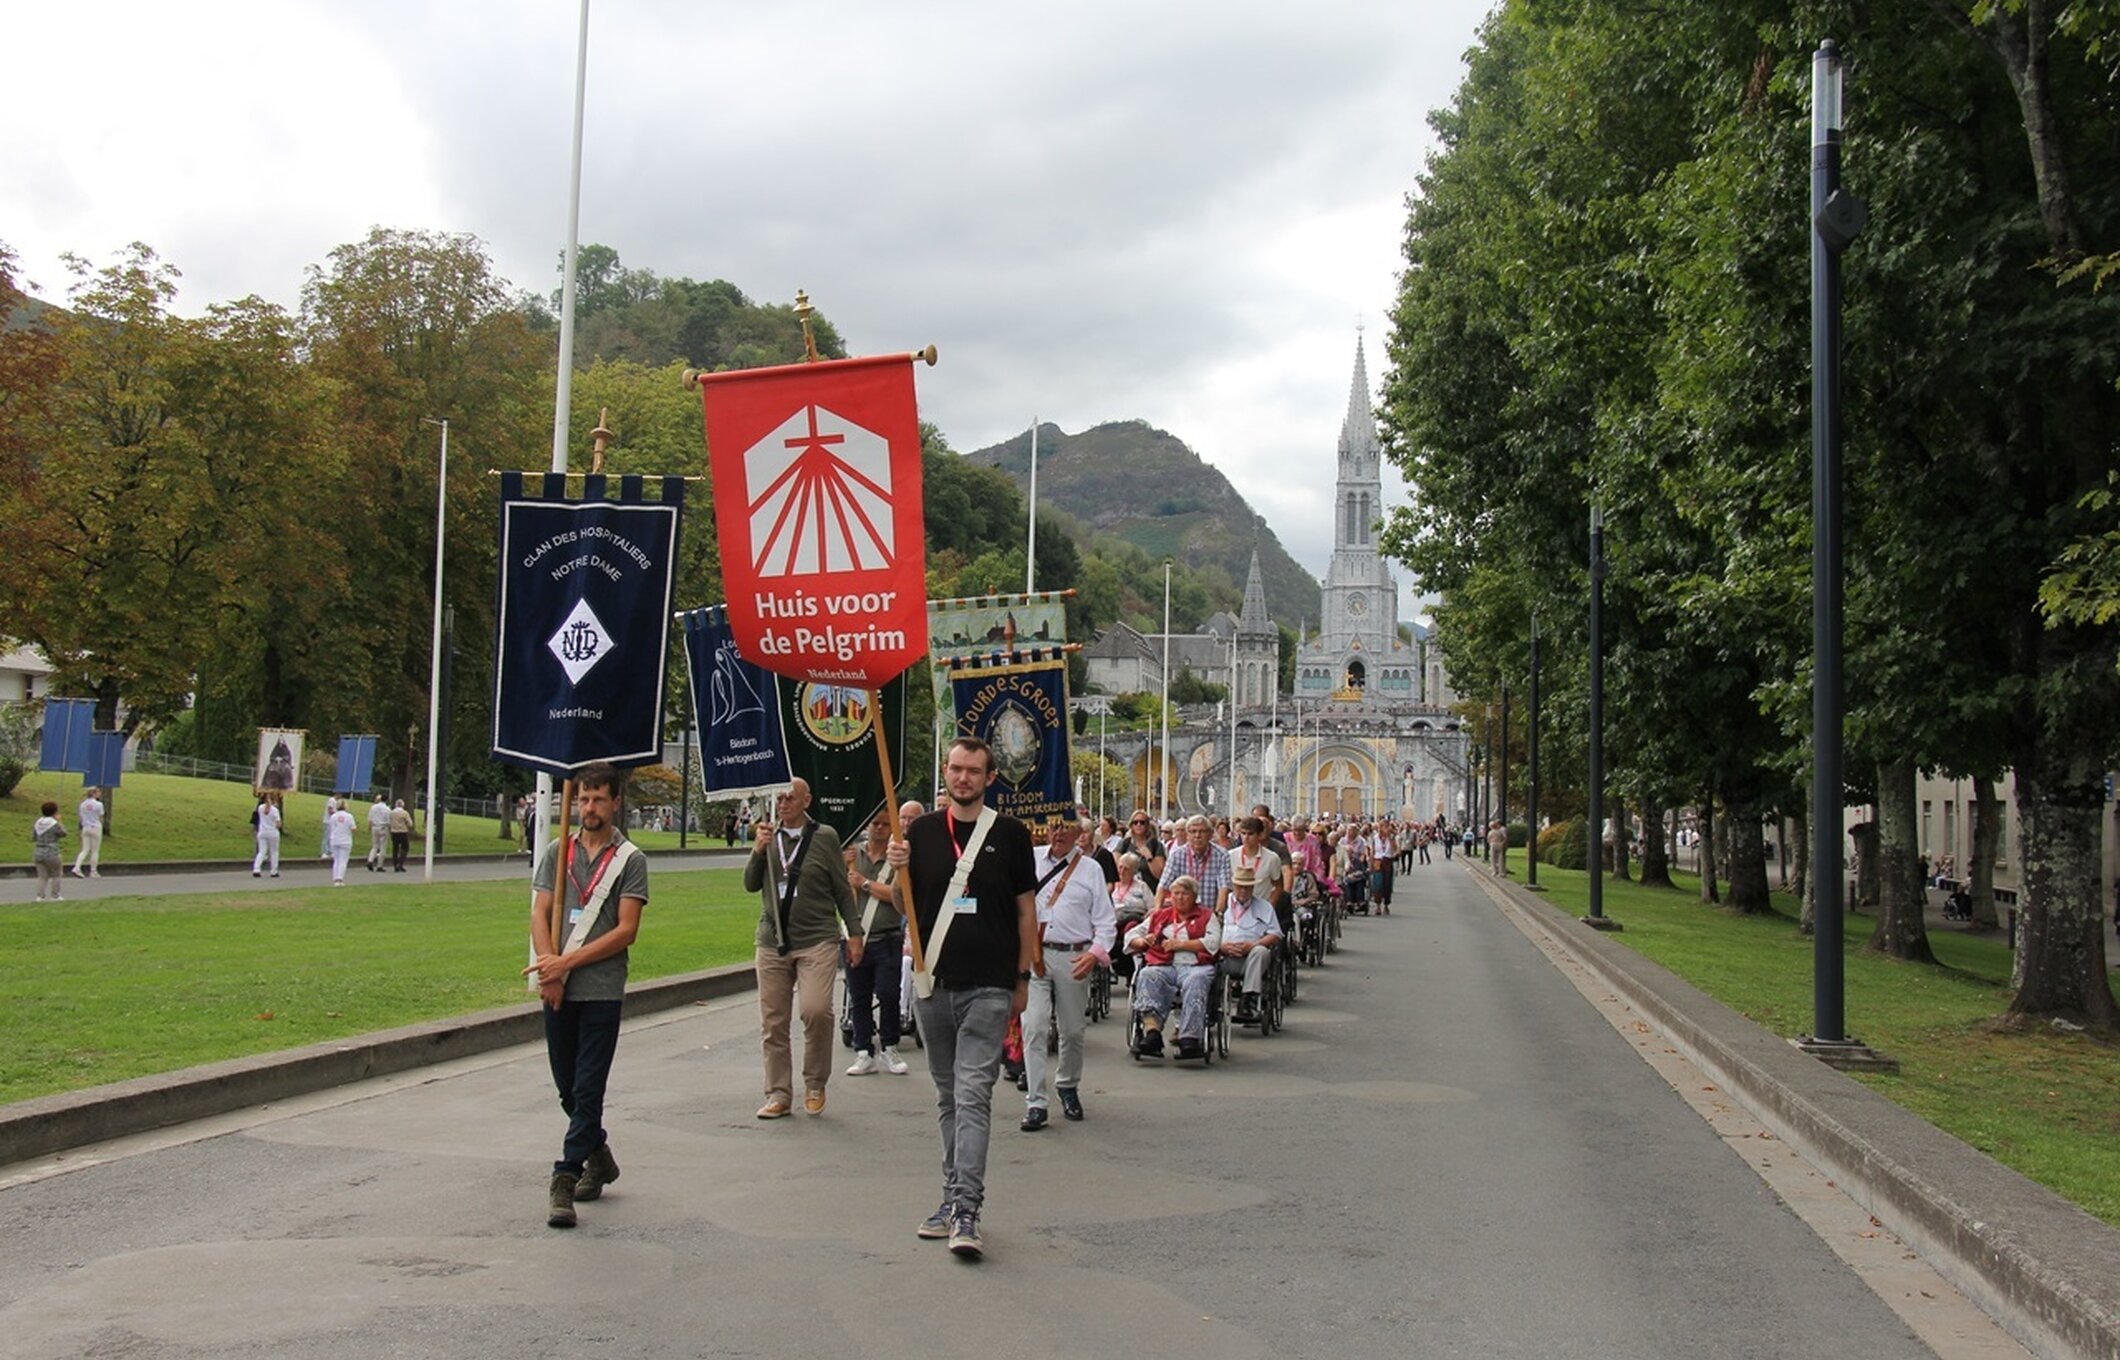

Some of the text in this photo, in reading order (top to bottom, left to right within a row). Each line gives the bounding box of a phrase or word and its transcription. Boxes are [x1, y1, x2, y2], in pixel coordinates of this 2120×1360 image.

[523, 526, 652, 570] CLAN DES HOSPITALIERS
[551, 554, 622, 582] NOTRE DAME
[755, 589, 897, 618] Huis voor
[759, 624, 905, 661] de Pelgrim
[807, 669, 867, 681] Nederland
[549, 706, 603, 720] Nederland
[729, 737, 758, 749] Bisdom
[997, 791, 1044, 805] BISDOM
